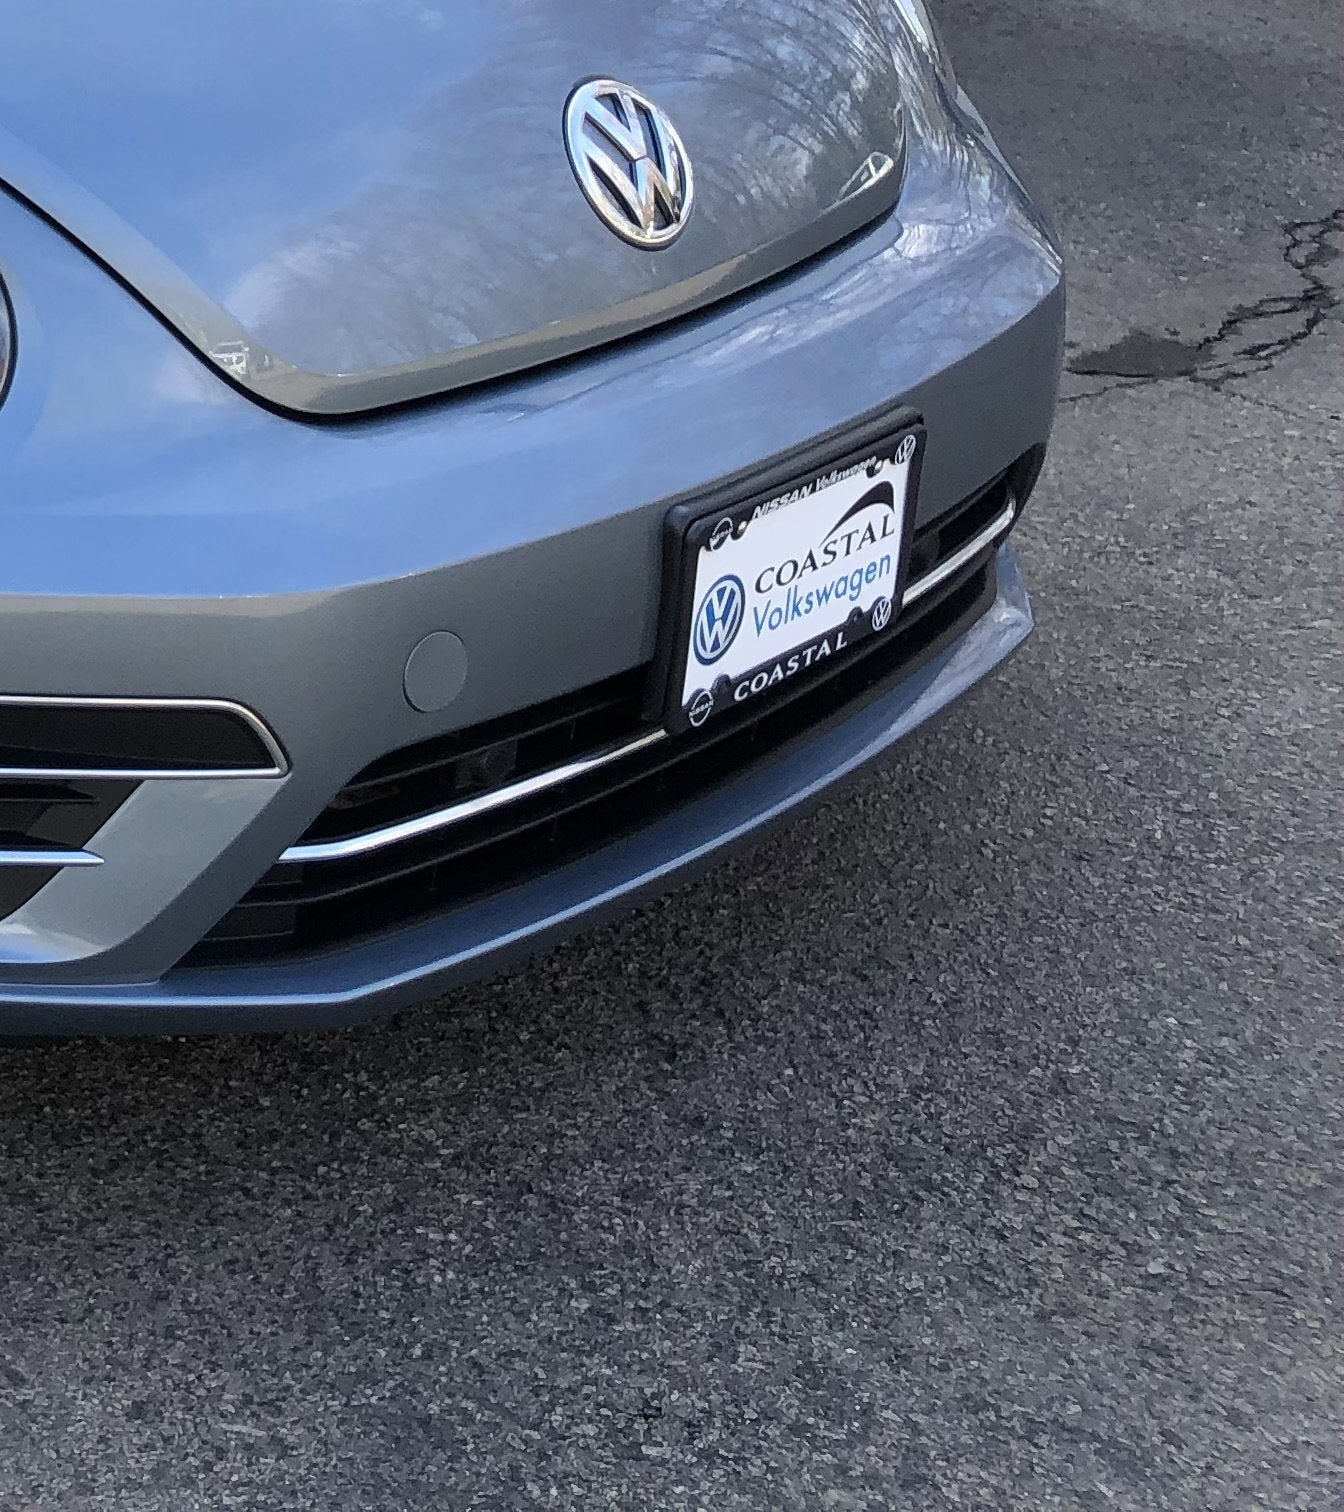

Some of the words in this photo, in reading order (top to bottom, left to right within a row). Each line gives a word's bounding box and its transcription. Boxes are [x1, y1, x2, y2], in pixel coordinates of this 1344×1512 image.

[566, 80, 694, 245] VW
[752, 483, 813, 520] NISSAN
[753, 553, 891, 635] Volkswagen
[755, 514, 896, 594] COASTAL
[694, 574, 746, 666] VW
[733, 631, 848, 702] COASTAL
